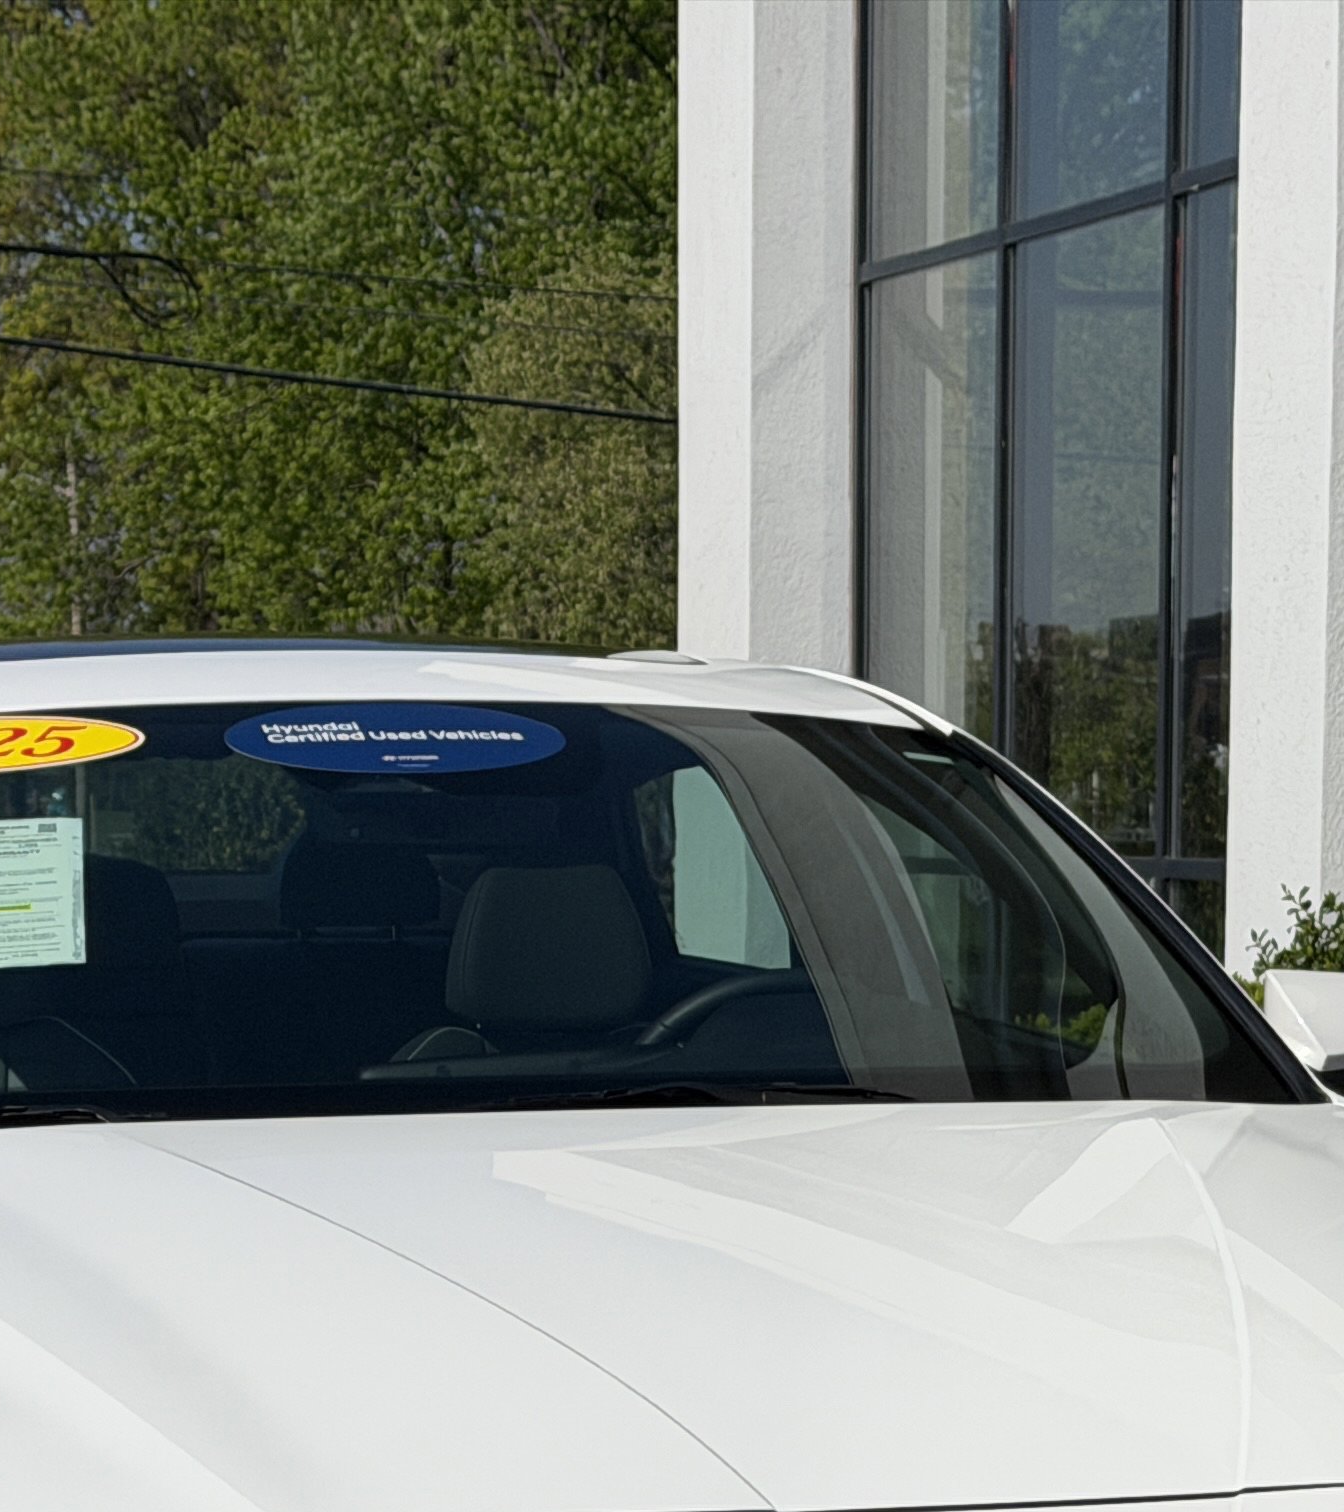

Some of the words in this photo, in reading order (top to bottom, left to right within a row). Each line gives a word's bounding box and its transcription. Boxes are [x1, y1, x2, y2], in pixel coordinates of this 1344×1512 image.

[261, 721, 360, 734] Hyundai
[267, 731, 366, 744] Certified
[368, 730, 428, 740] Used
[428, 729, 524, 741] Vehicles
